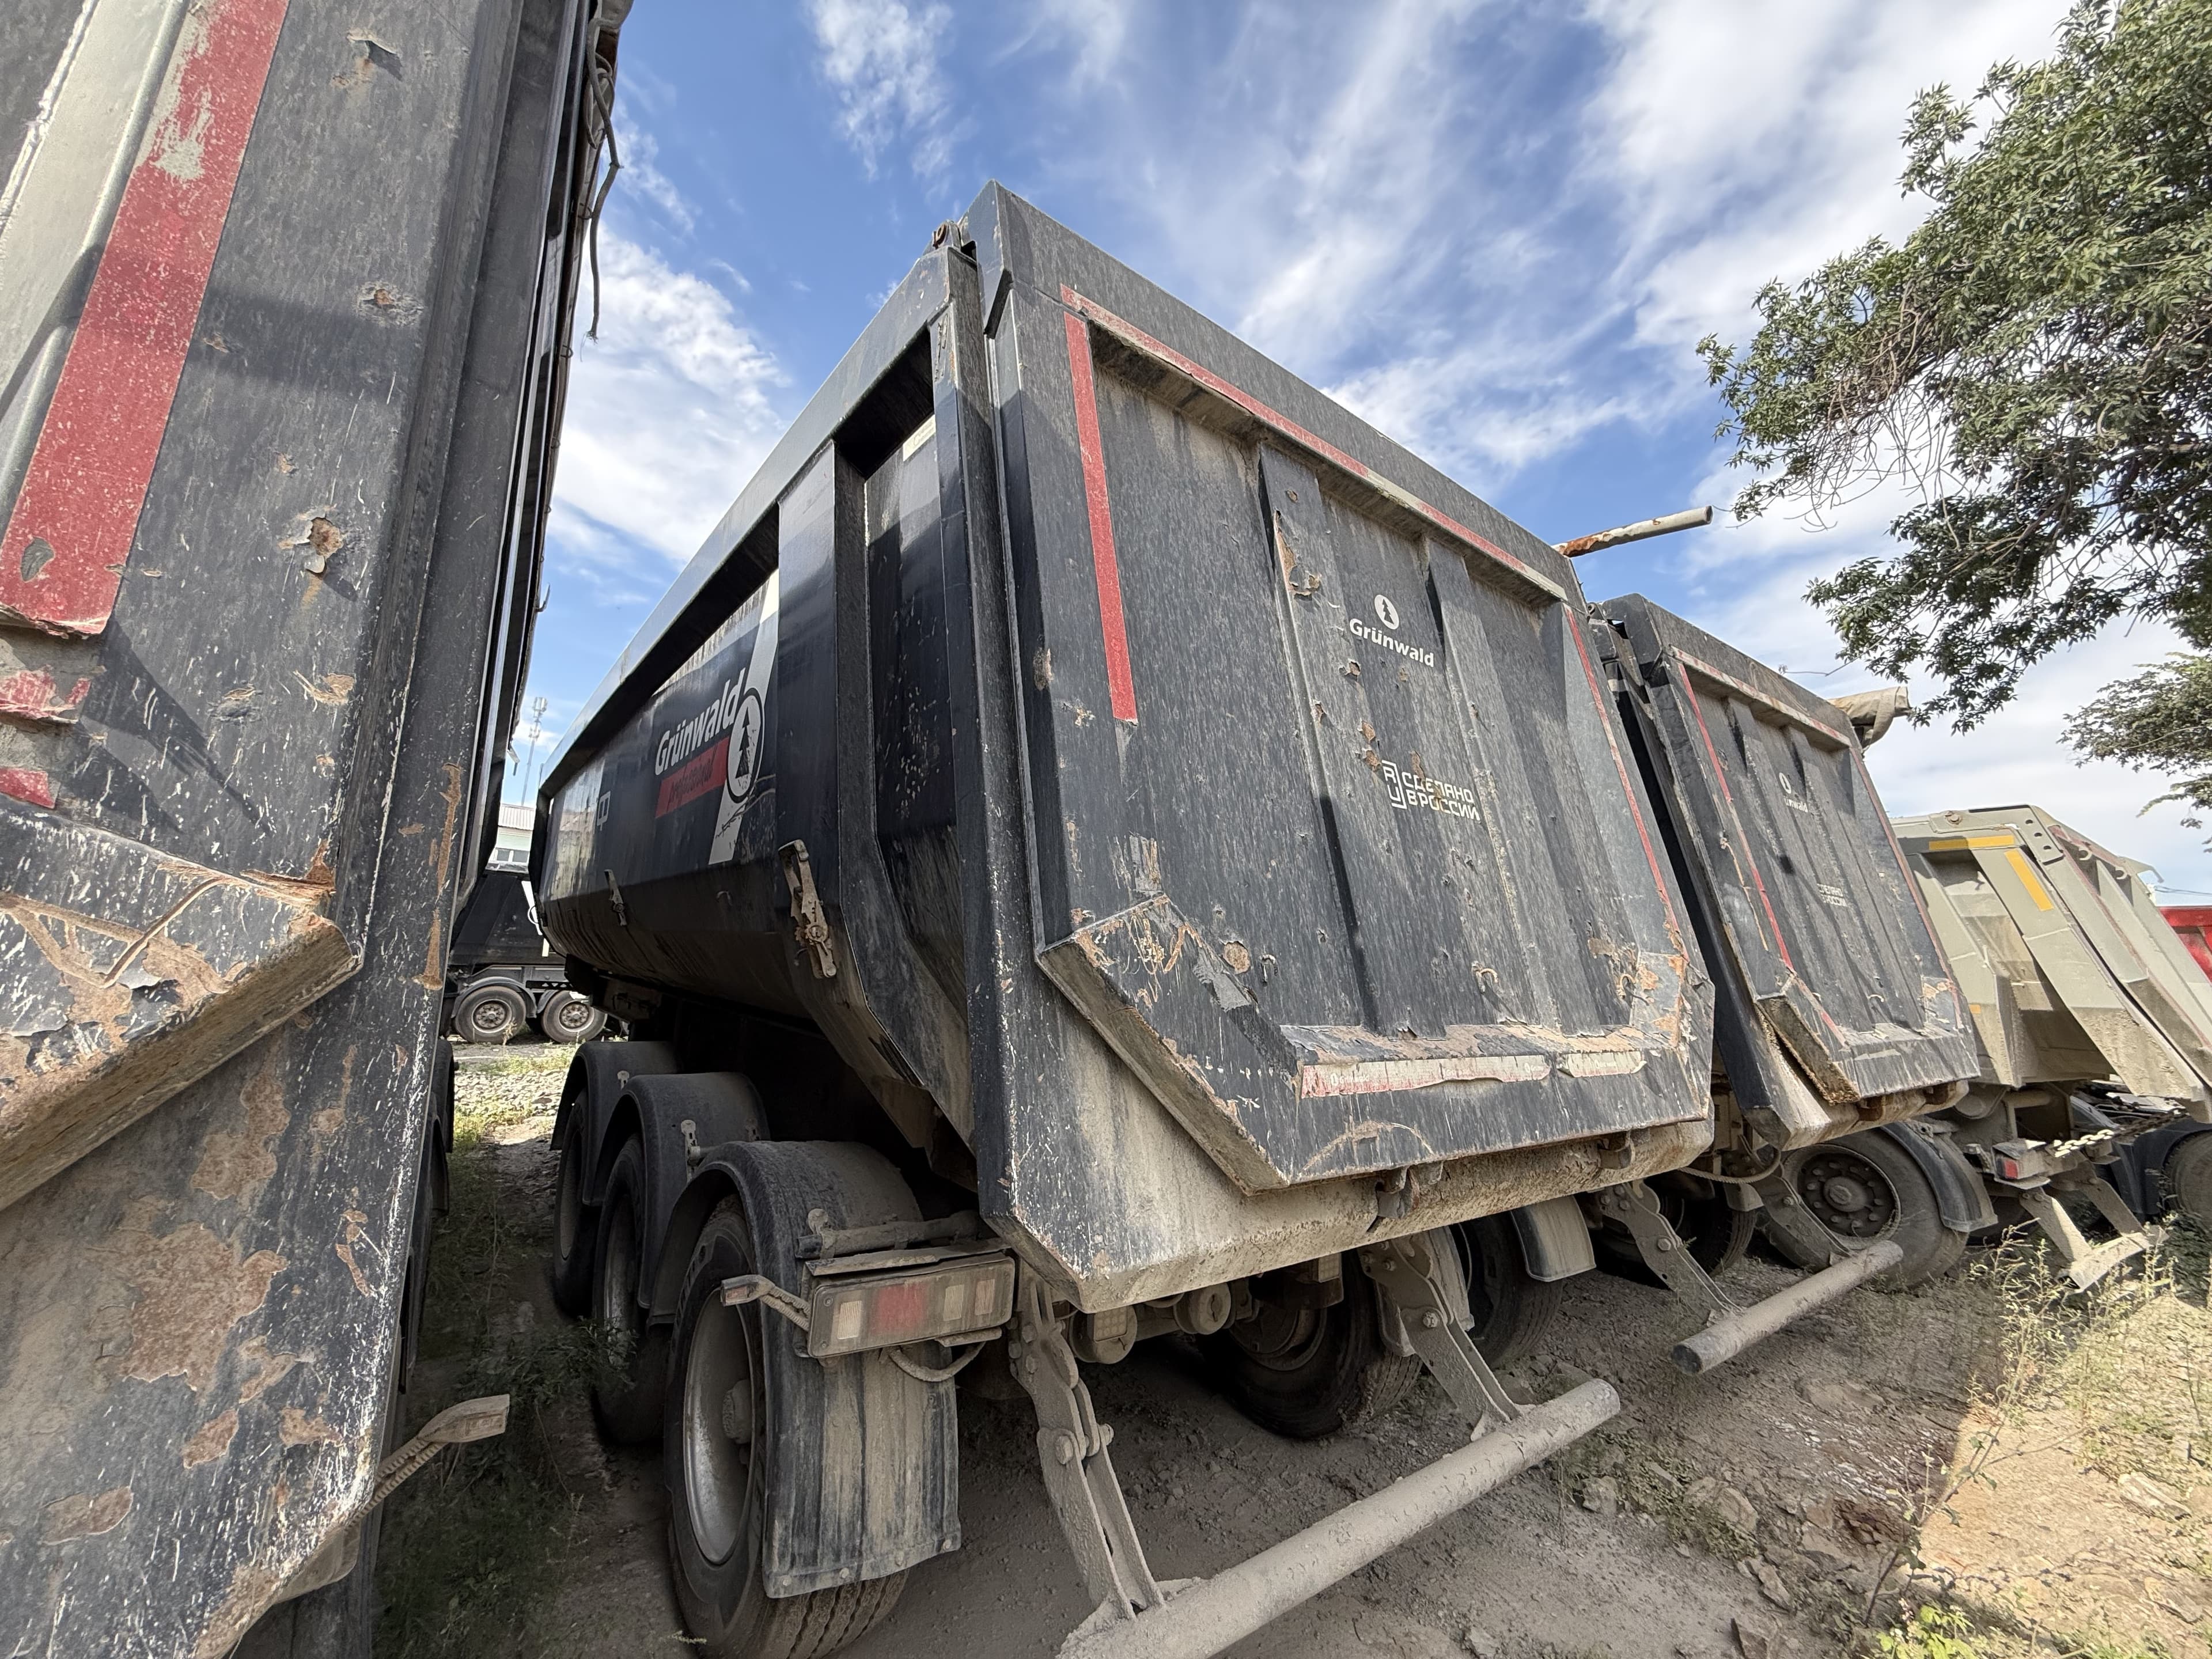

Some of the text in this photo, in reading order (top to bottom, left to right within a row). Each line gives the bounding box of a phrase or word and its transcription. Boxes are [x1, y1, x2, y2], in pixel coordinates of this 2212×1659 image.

[1350, 619, 1434, 667] Grünwald
[655, 668, 746, 775] Grünwald
[1402, 771, 1474, 804] СДЕЛАНО
